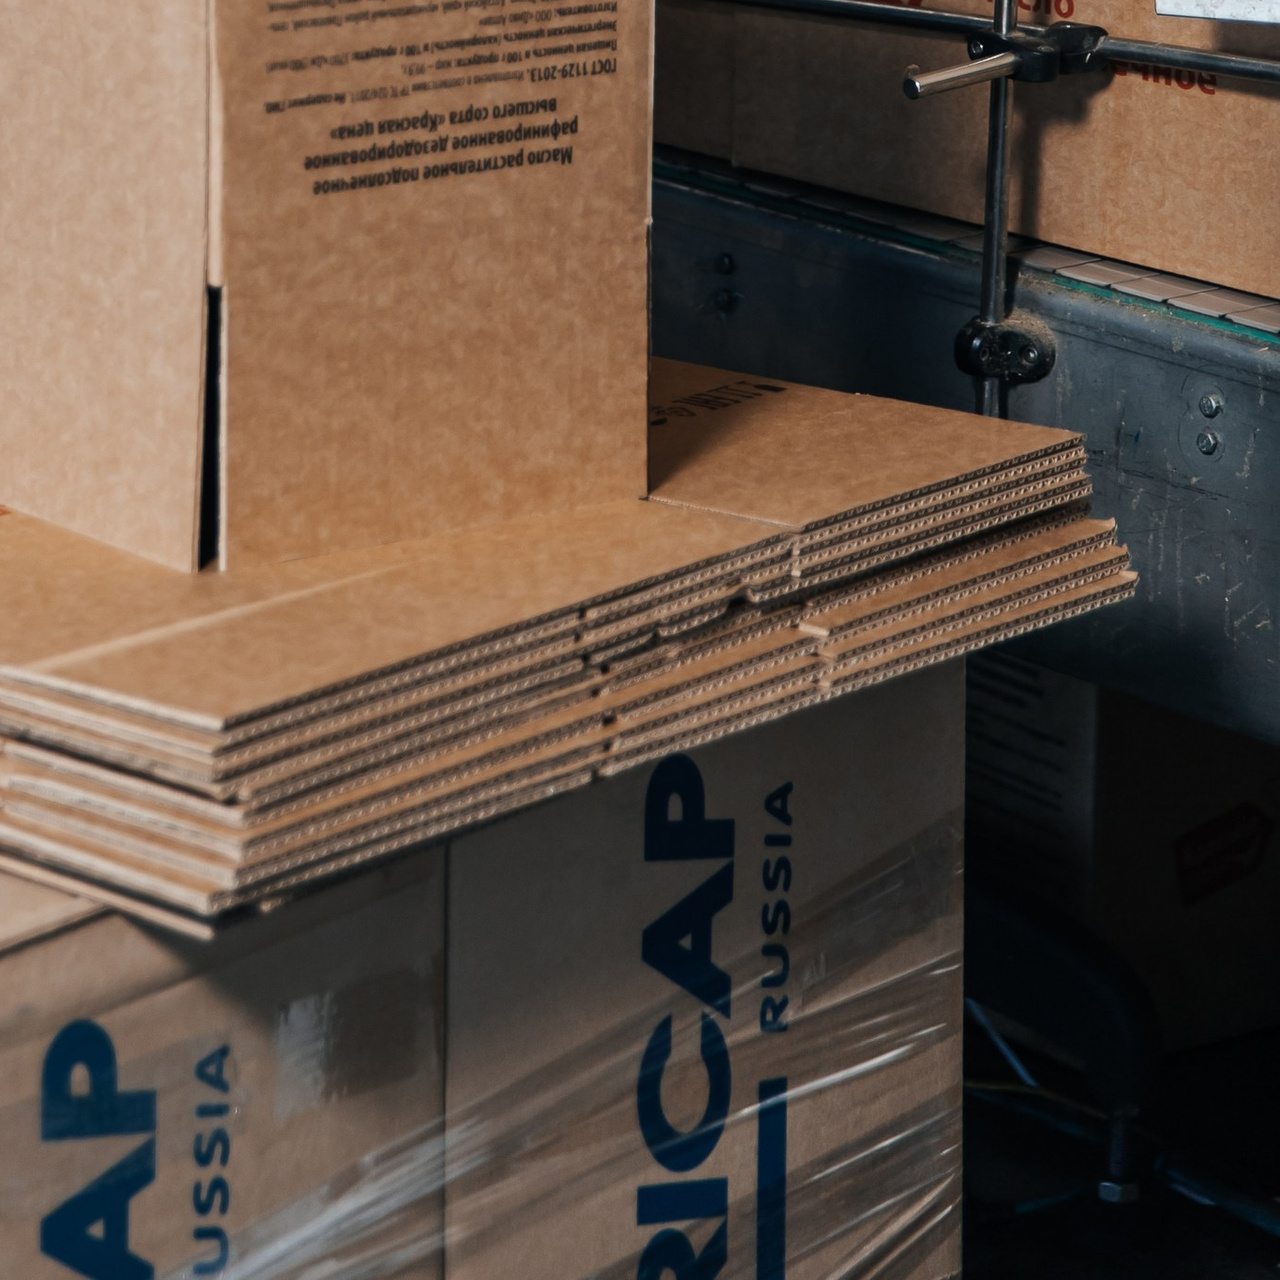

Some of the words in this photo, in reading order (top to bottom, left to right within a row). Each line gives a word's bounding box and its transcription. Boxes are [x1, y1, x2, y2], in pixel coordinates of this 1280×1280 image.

[535, 8, 552, 22] ООО
[554, 1, 617, 17] Изготовитель:
[532, 43, 574, 58] ценность
[576, 38, 617, 53] Пищевая
[506, 51, 522, 63] 100
[590, 57, 616, 75] ГОСТ
[526, 61, 589, 83] 1129-2013.
[449, 103, 489, 125] сорта
[492, 97, 556, 119] высшего
[329, 119, 374, 140] цена»
[377, 109, 445, 135] «Красная
[452, 115, 578, 151] рафинированное
[304, 134, 448, 171] дезодорированное
[527, 145, 573, 166] Масло
[422, 148, 524, 180] растительное
[312, 166, 419, 195] подсолнечное
[759, 781, 794, 1033] RUSSIA
